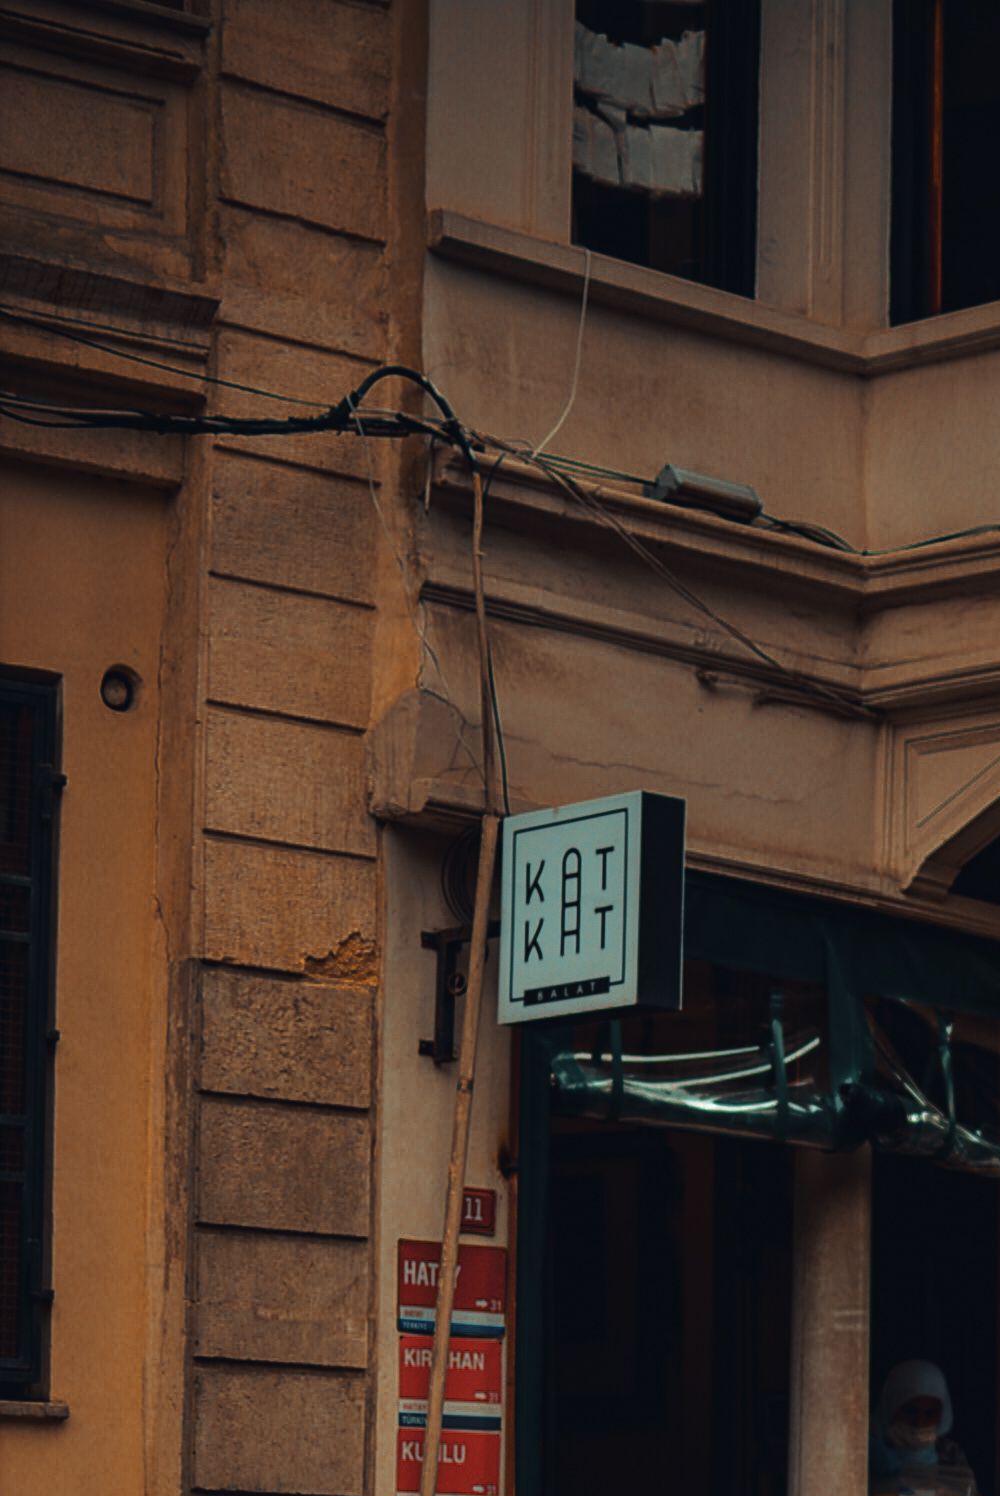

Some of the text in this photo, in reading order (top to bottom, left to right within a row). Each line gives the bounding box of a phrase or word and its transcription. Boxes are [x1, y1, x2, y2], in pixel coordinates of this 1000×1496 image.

[526, 846, 615, 905] KAT
[536, 983, 597, 1001] BALAT
[464, 1197, 483, 1221] 11
[403, 1259, 462, 1288] HATY
[490, 1299, 502, 1311] 31
[403, 1348, 485, 1371] KIRHAN
[402, 1441, 466, 1463] KULU
